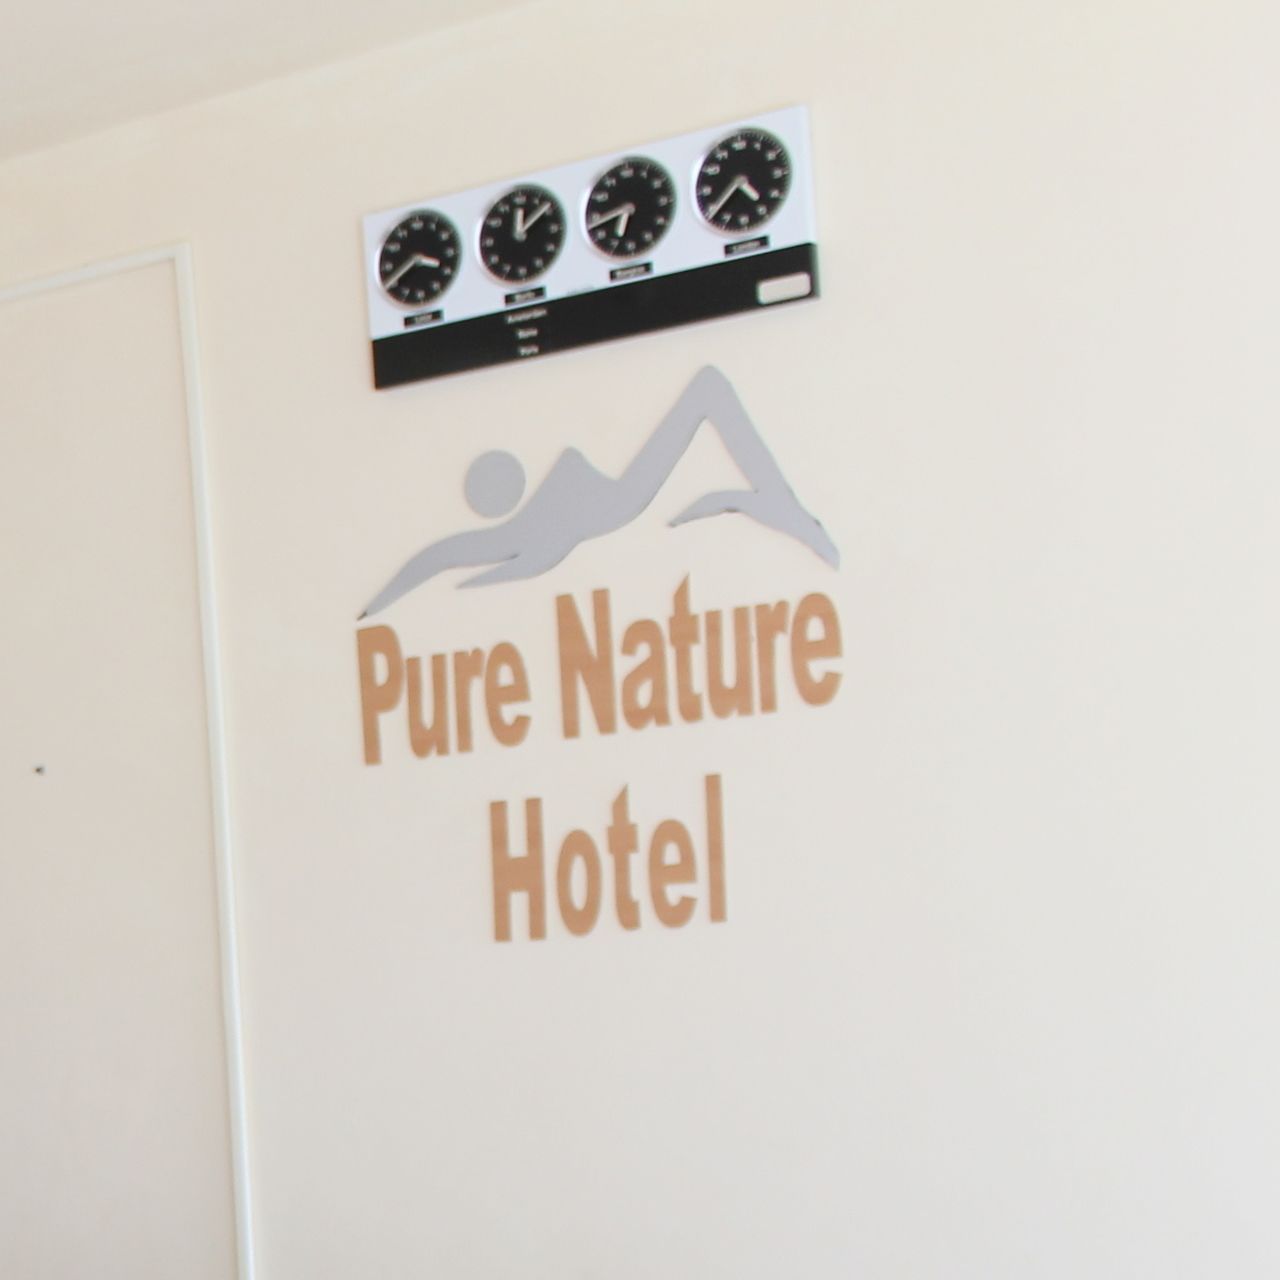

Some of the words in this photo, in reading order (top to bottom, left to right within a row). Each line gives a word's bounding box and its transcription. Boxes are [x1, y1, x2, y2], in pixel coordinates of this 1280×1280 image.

[356, 624, 532, 766] Pure
[554, 571, 844, 740] Nature
[489, 773, 728, 943] Hotel
